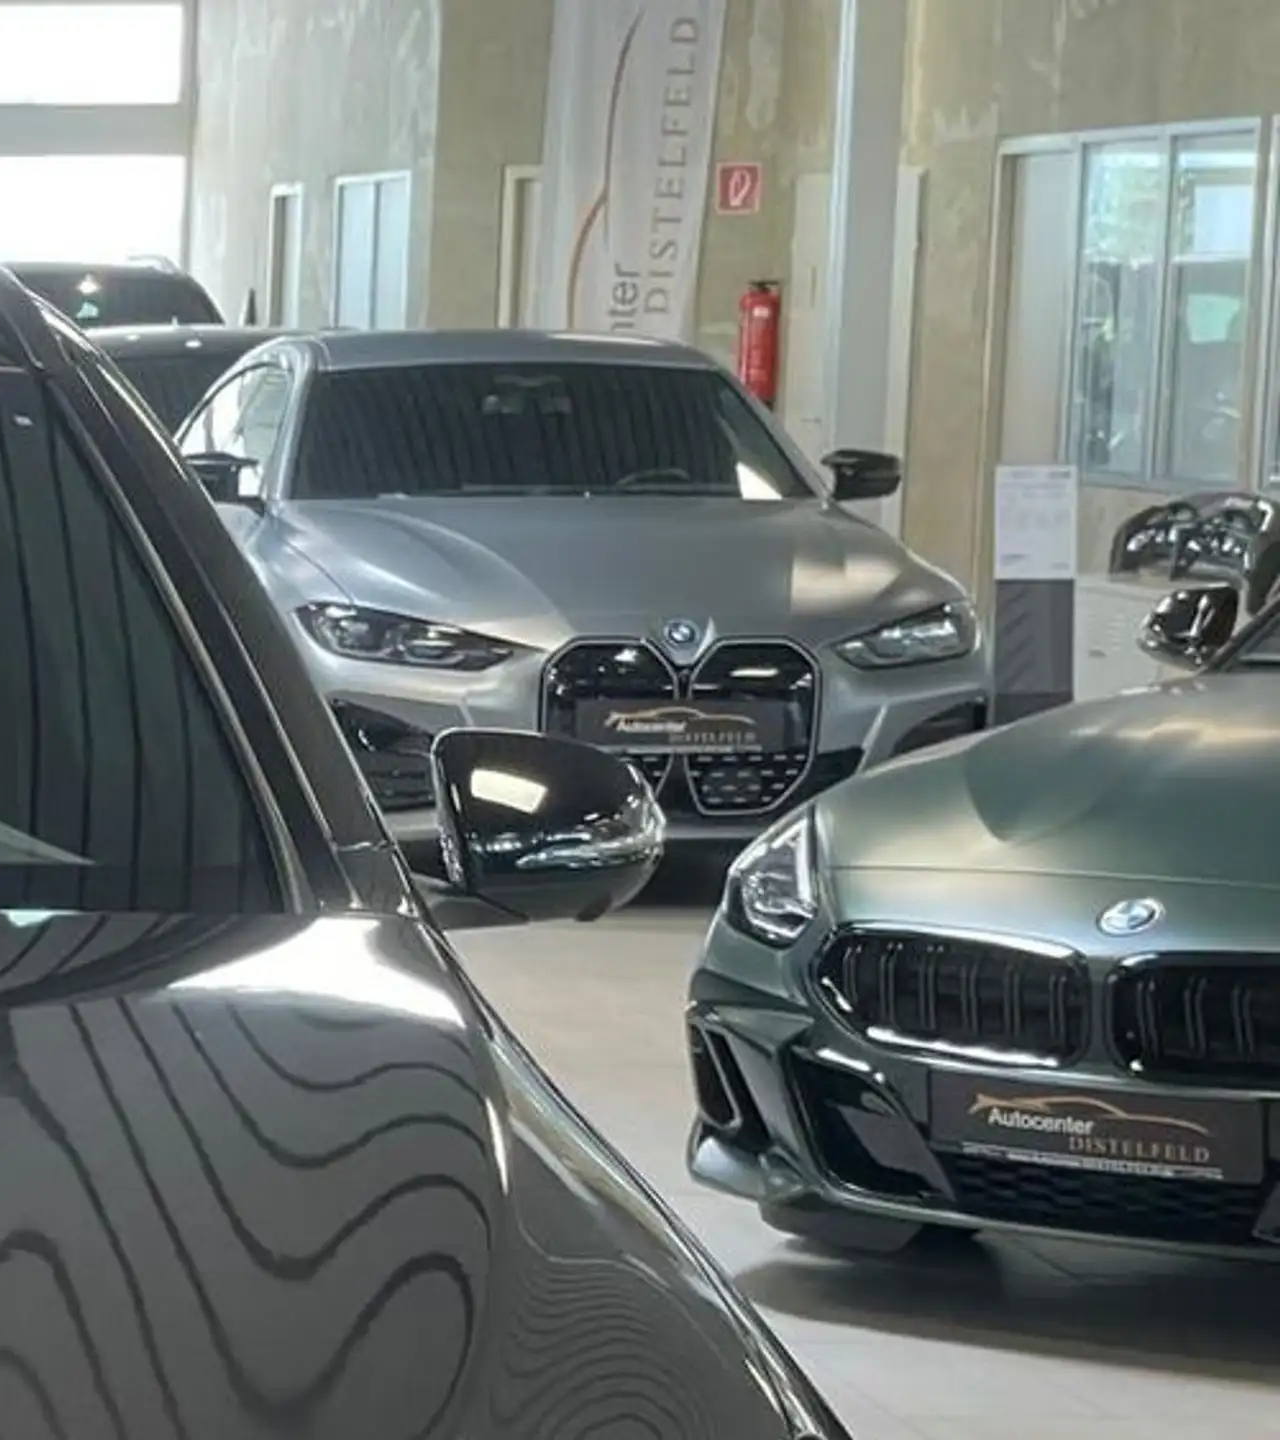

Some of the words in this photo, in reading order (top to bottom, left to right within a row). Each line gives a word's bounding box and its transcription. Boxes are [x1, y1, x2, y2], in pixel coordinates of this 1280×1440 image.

[643, 16, 699, 314] DISTELFELD
[988, 1107, 1094, 1136] Autocenter
[1068, 1135, 1210, 1163] DISTELFELD
